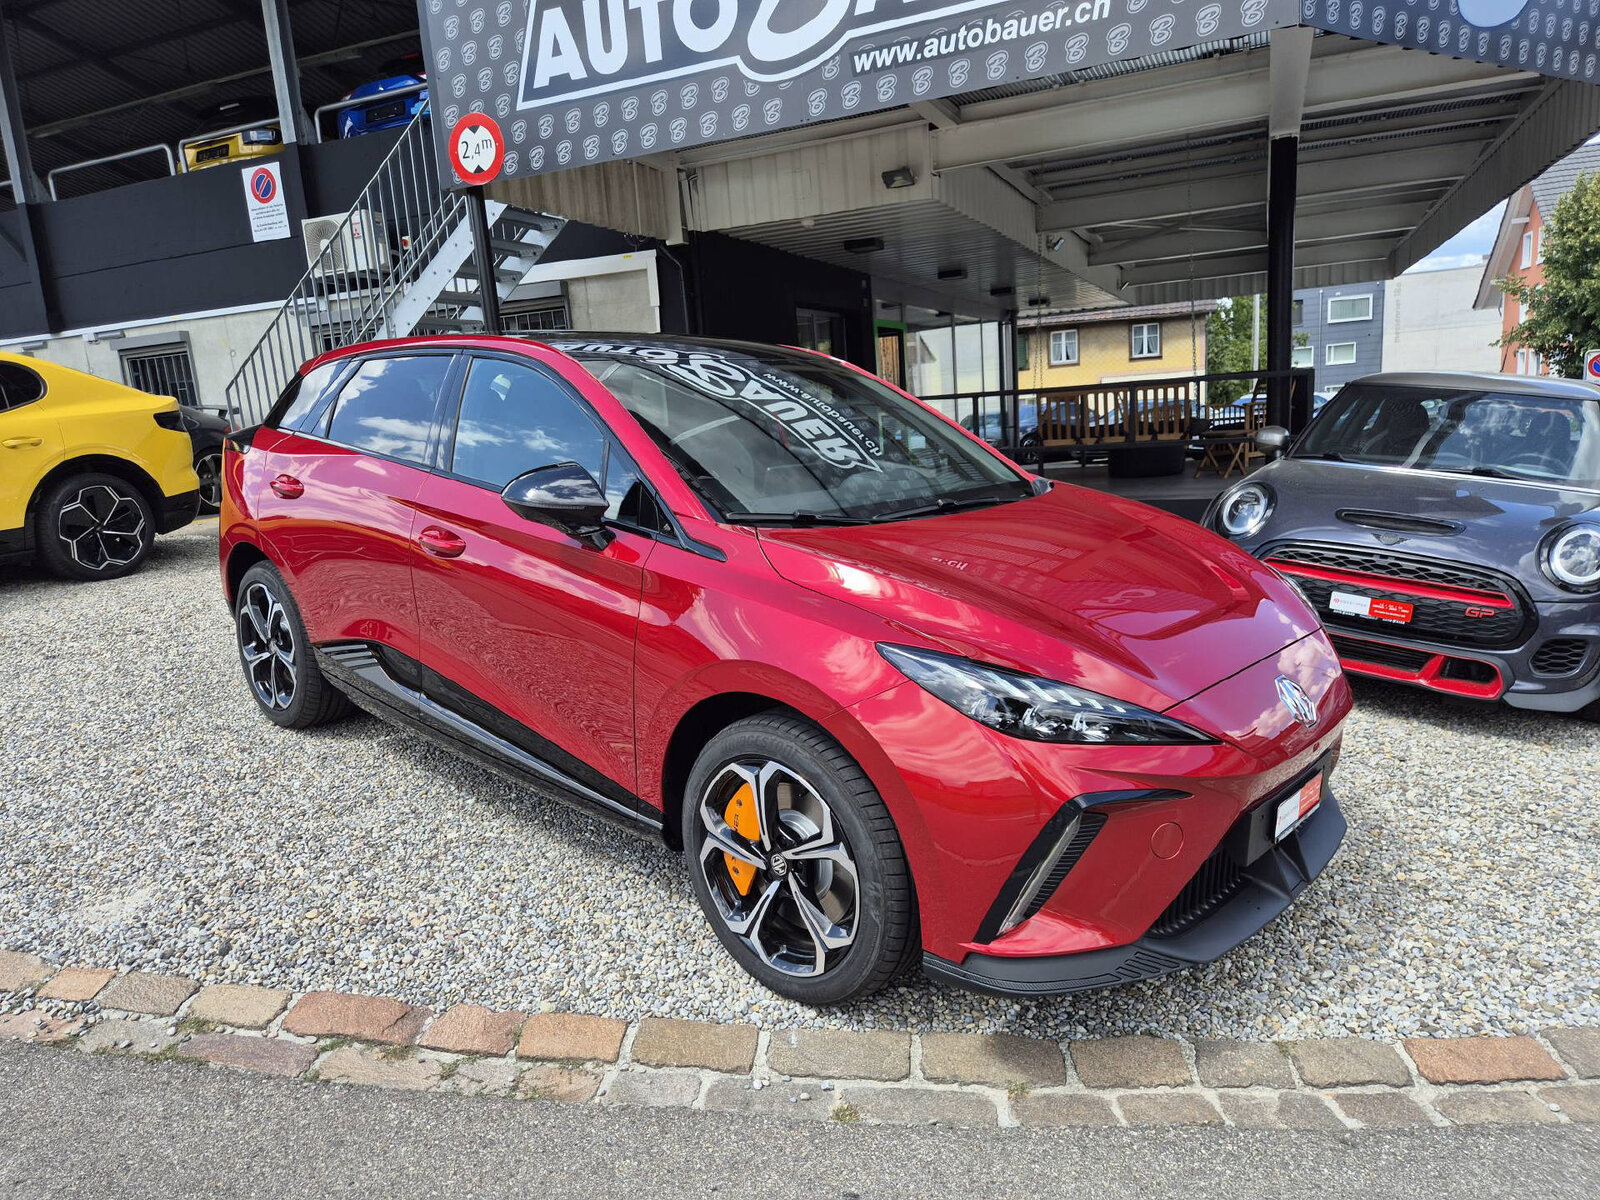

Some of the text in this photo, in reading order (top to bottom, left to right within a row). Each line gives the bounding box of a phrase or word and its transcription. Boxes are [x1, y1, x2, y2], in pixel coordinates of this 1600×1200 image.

[533, 0, 738, 89] AUTO
[853, 0, 1111, 73] www.autobauer.ch
[1464, 606, 1495, 618] GP
